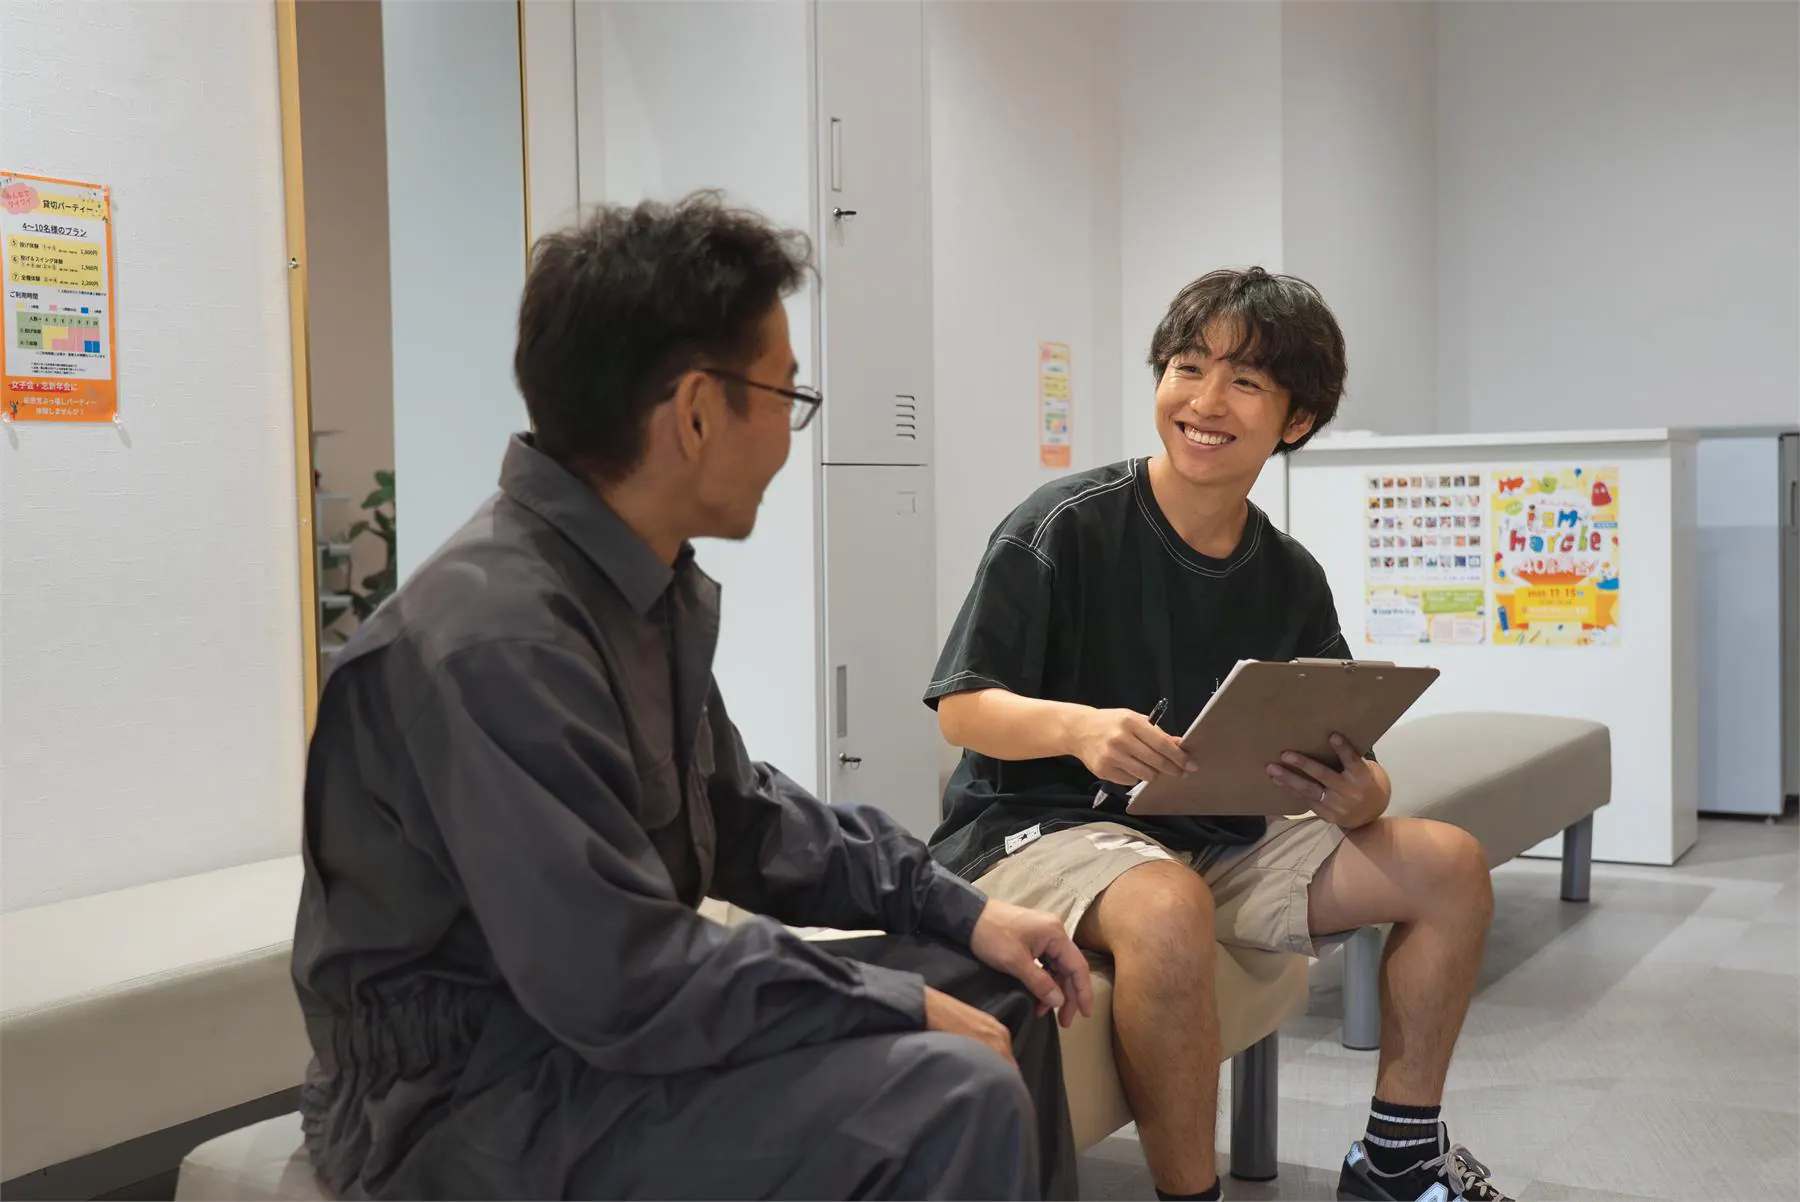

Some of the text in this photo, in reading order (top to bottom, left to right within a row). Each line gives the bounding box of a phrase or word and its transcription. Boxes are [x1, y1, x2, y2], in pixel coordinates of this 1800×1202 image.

[9, 291, 39, 300] ご利用時間
